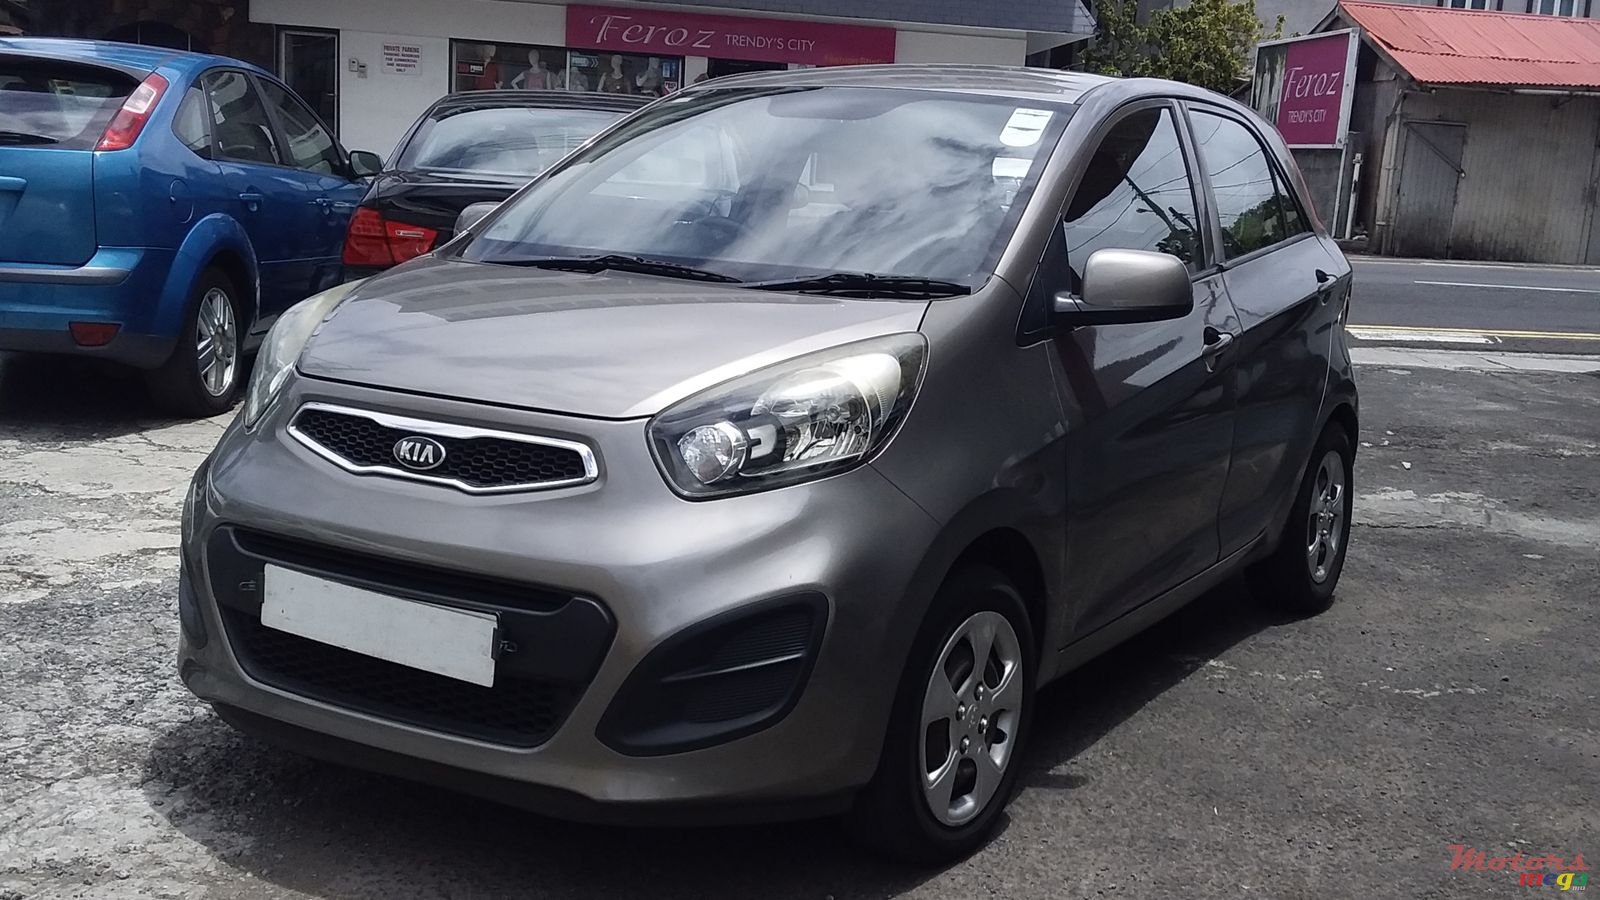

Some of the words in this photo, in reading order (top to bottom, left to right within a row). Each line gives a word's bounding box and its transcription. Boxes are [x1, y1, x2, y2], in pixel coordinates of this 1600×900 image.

[590, 14, 716, 48] Feroz
[725, 34, 784, 49] TRENDY'S
[787, 39, 816, 51] CITY
[1284, 67, 1340, 102] Feroz
[1313, 109, 1327, 122] CITY
[400, 440, 434, 464] KIA
